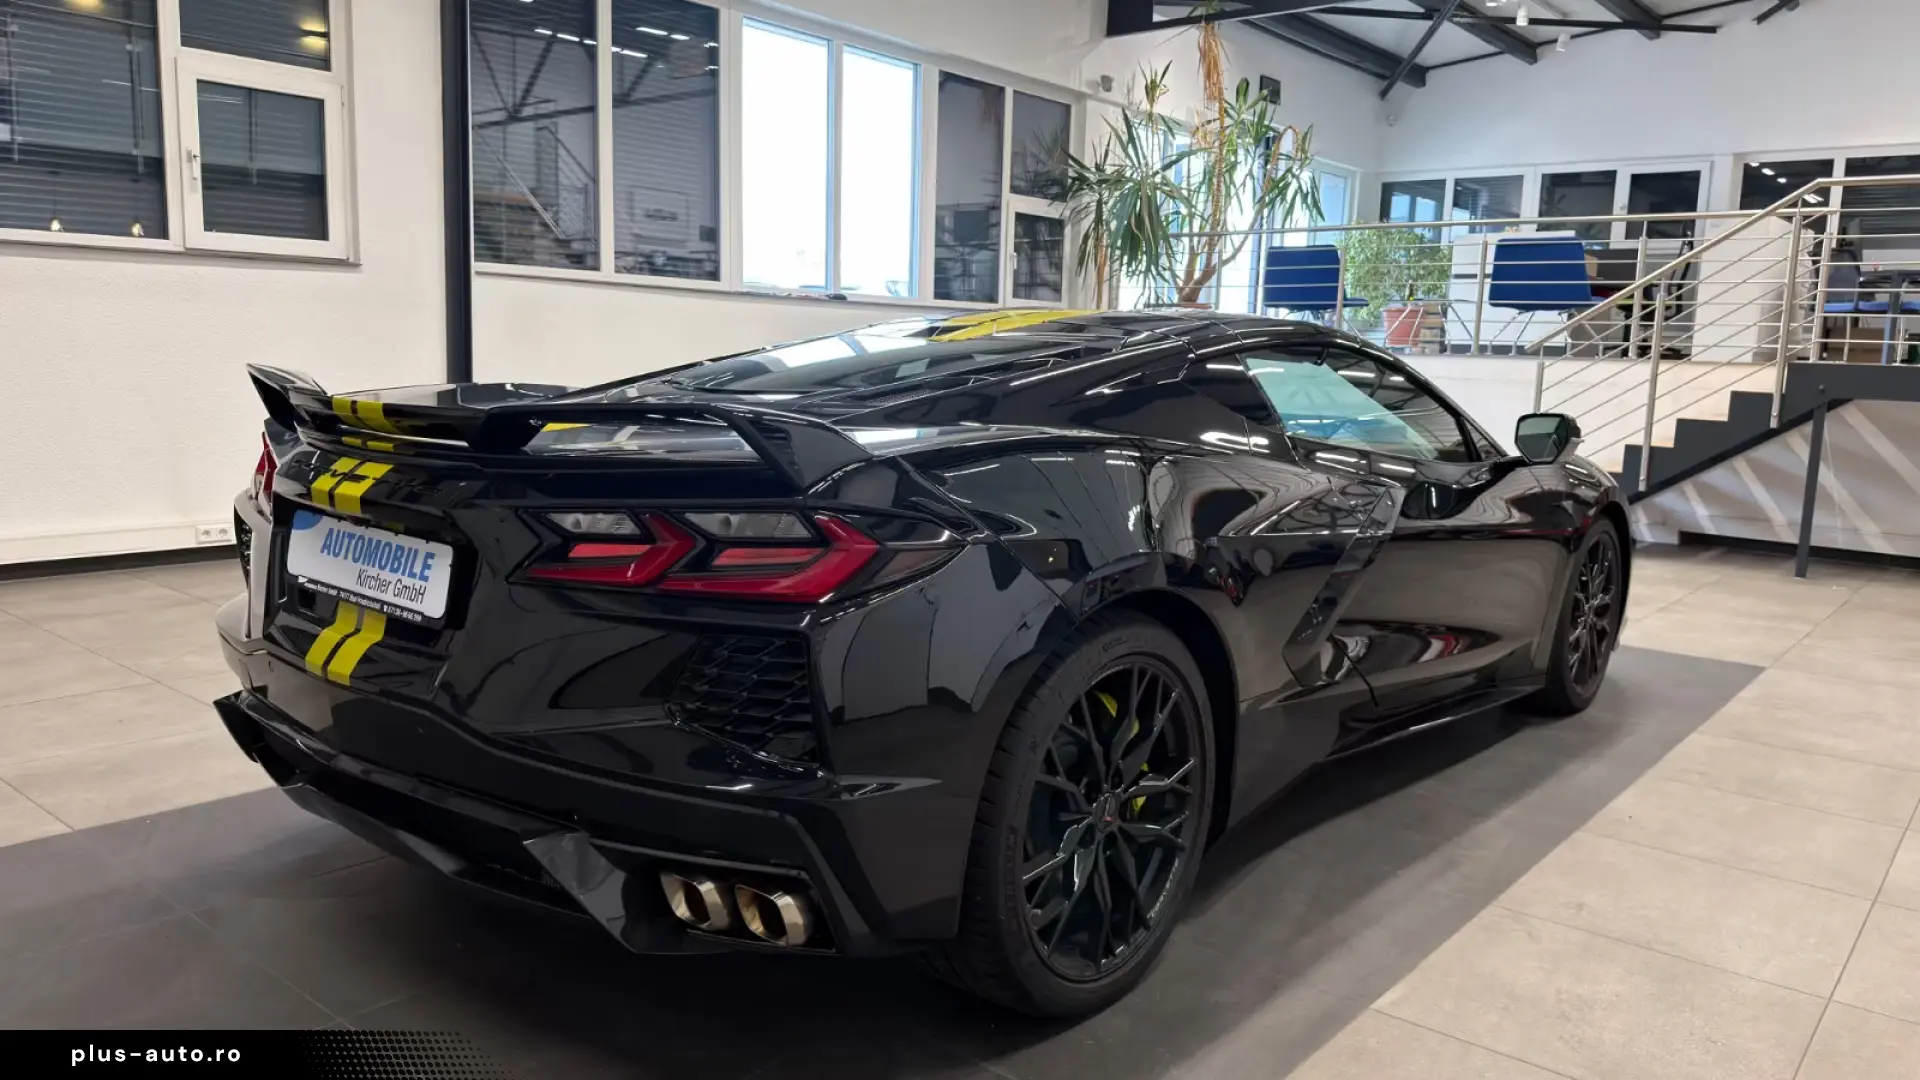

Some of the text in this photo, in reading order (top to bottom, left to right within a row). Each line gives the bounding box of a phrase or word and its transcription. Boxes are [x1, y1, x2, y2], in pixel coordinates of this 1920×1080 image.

[320, 527, 436, 583] AUTOMOBILE
[356, 568, 392, 595] Kircher
[393, 578, 427, 604] GmbH
